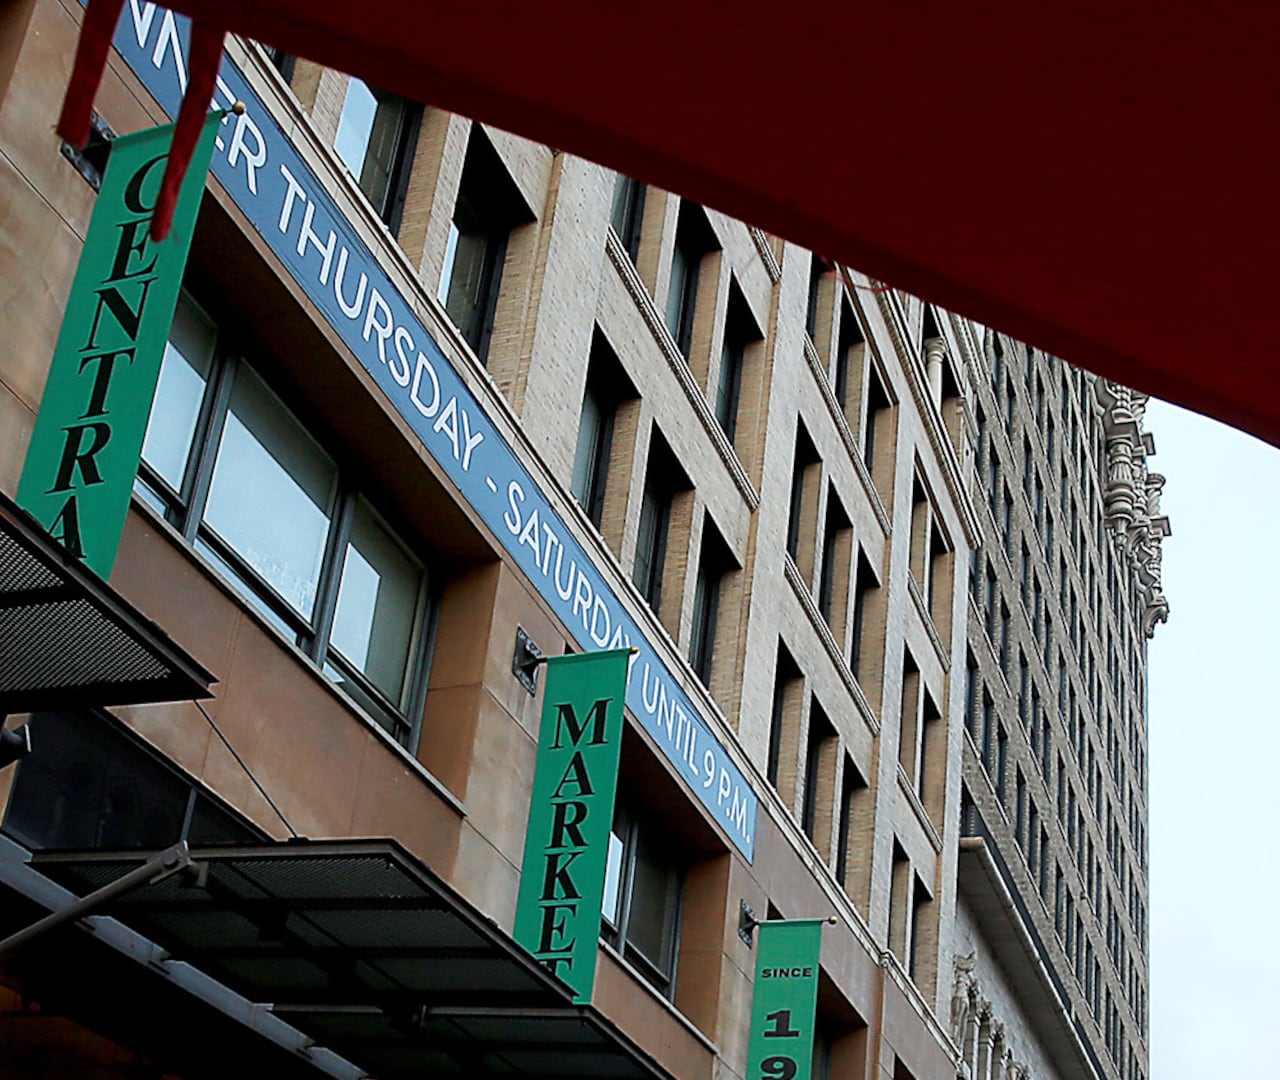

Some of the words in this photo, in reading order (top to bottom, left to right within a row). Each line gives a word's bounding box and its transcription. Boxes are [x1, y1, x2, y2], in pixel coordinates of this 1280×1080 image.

[277, 163, 484, 471] THURSDAY
[642, 662, 699, 776] UNTIL
[703, 750, 715, 788] 9
[718, 767, 751, 844] P.M.
[761, 967, 813, 979] SINCE
